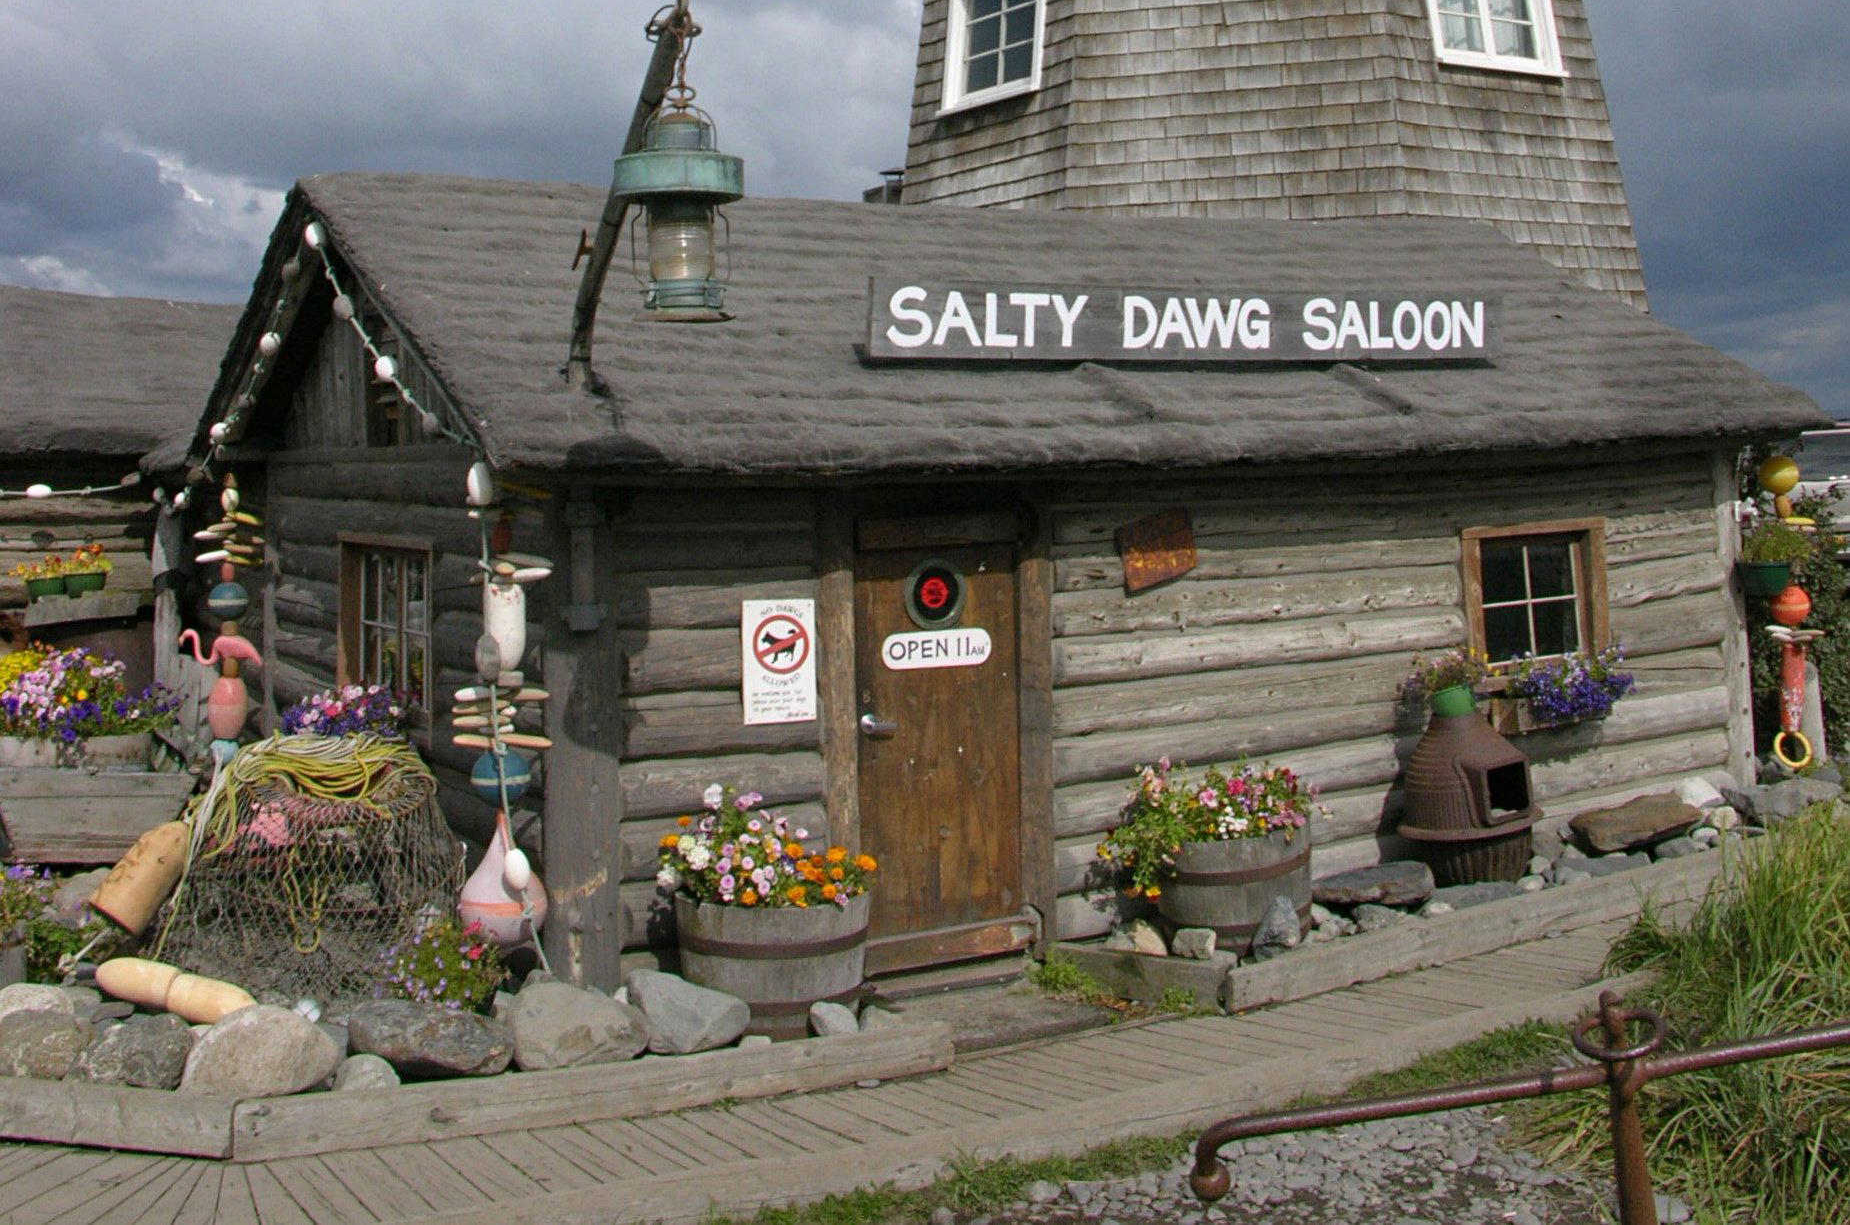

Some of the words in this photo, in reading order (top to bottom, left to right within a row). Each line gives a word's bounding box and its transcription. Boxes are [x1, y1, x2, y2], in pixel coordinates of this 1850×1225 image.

[886, 286, 1089, 348] SALTY
[1123, 296, 1270, 349] DAWG
[1302, 298, 1484, 351] SALOON
[760, 606, 773, 618] NO
[776, 604, 804, 619] DAWGS
[889, 638, 949, 661] OPEN
[760, 672, 801, 686] ALLOWED
